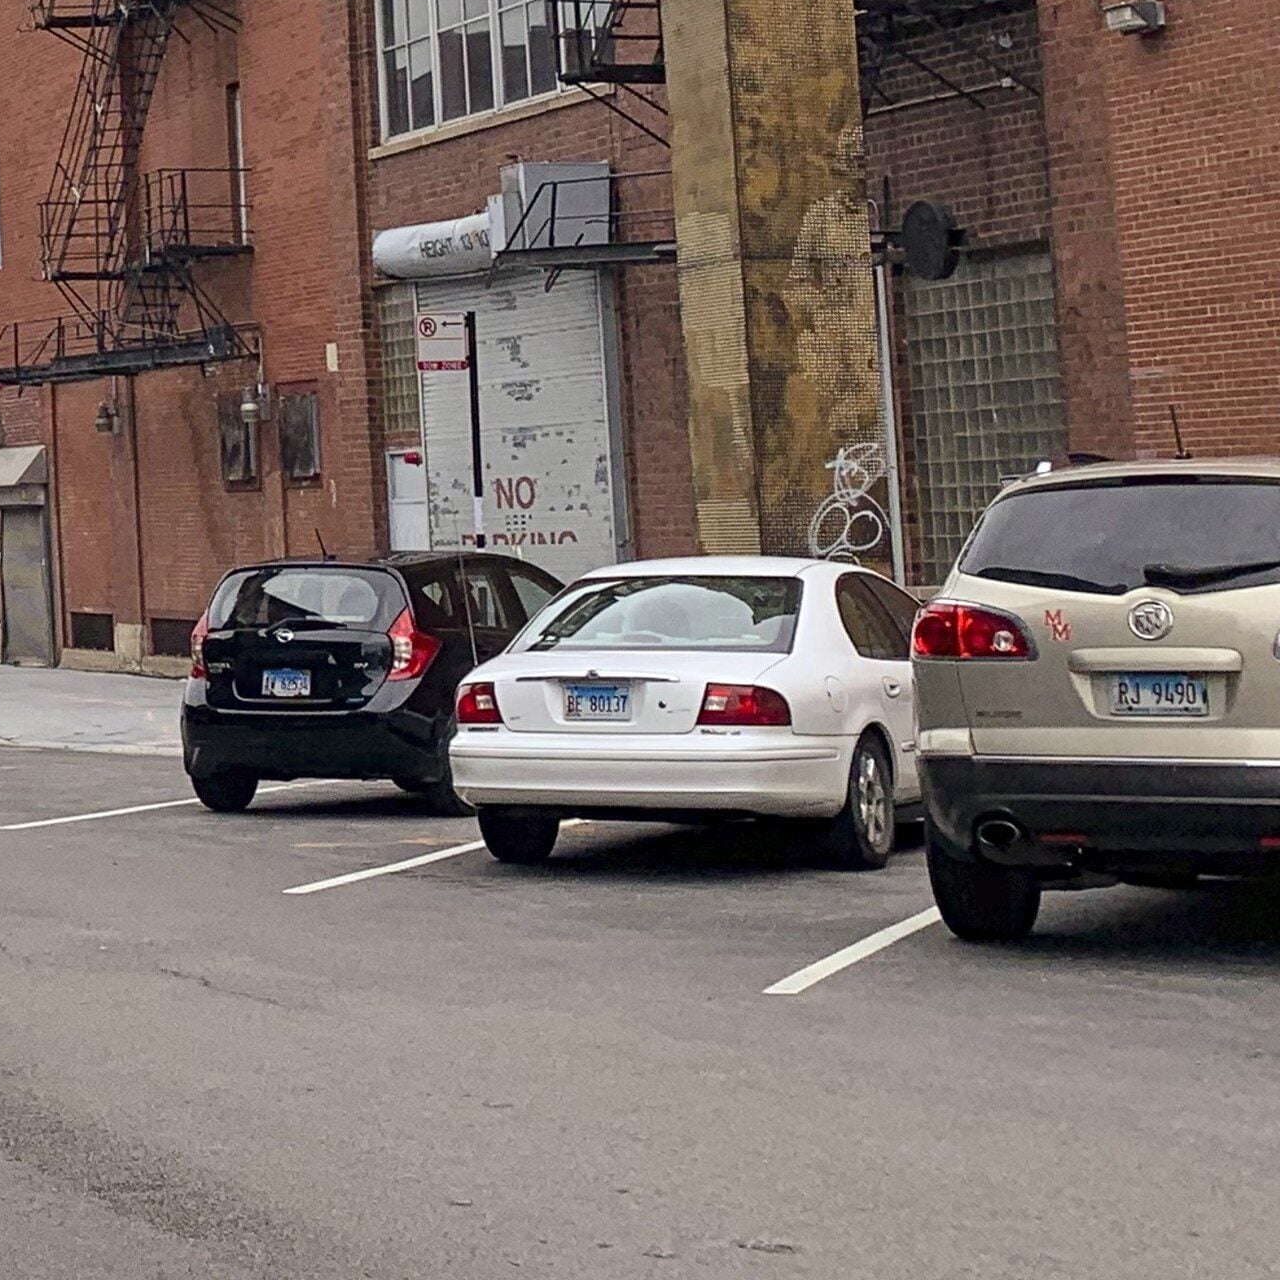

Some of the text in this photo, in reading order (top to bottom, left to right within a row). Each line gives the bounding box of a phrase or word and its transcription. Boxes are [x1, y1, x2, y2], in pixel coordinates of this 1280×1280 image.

[419, 236, 453, 259] HEIGHT
[494, 476, 536, 510] NO
[567, 694, 628, 713] BE 80137
[1118, 682, 1196, 705] RJ 9490
